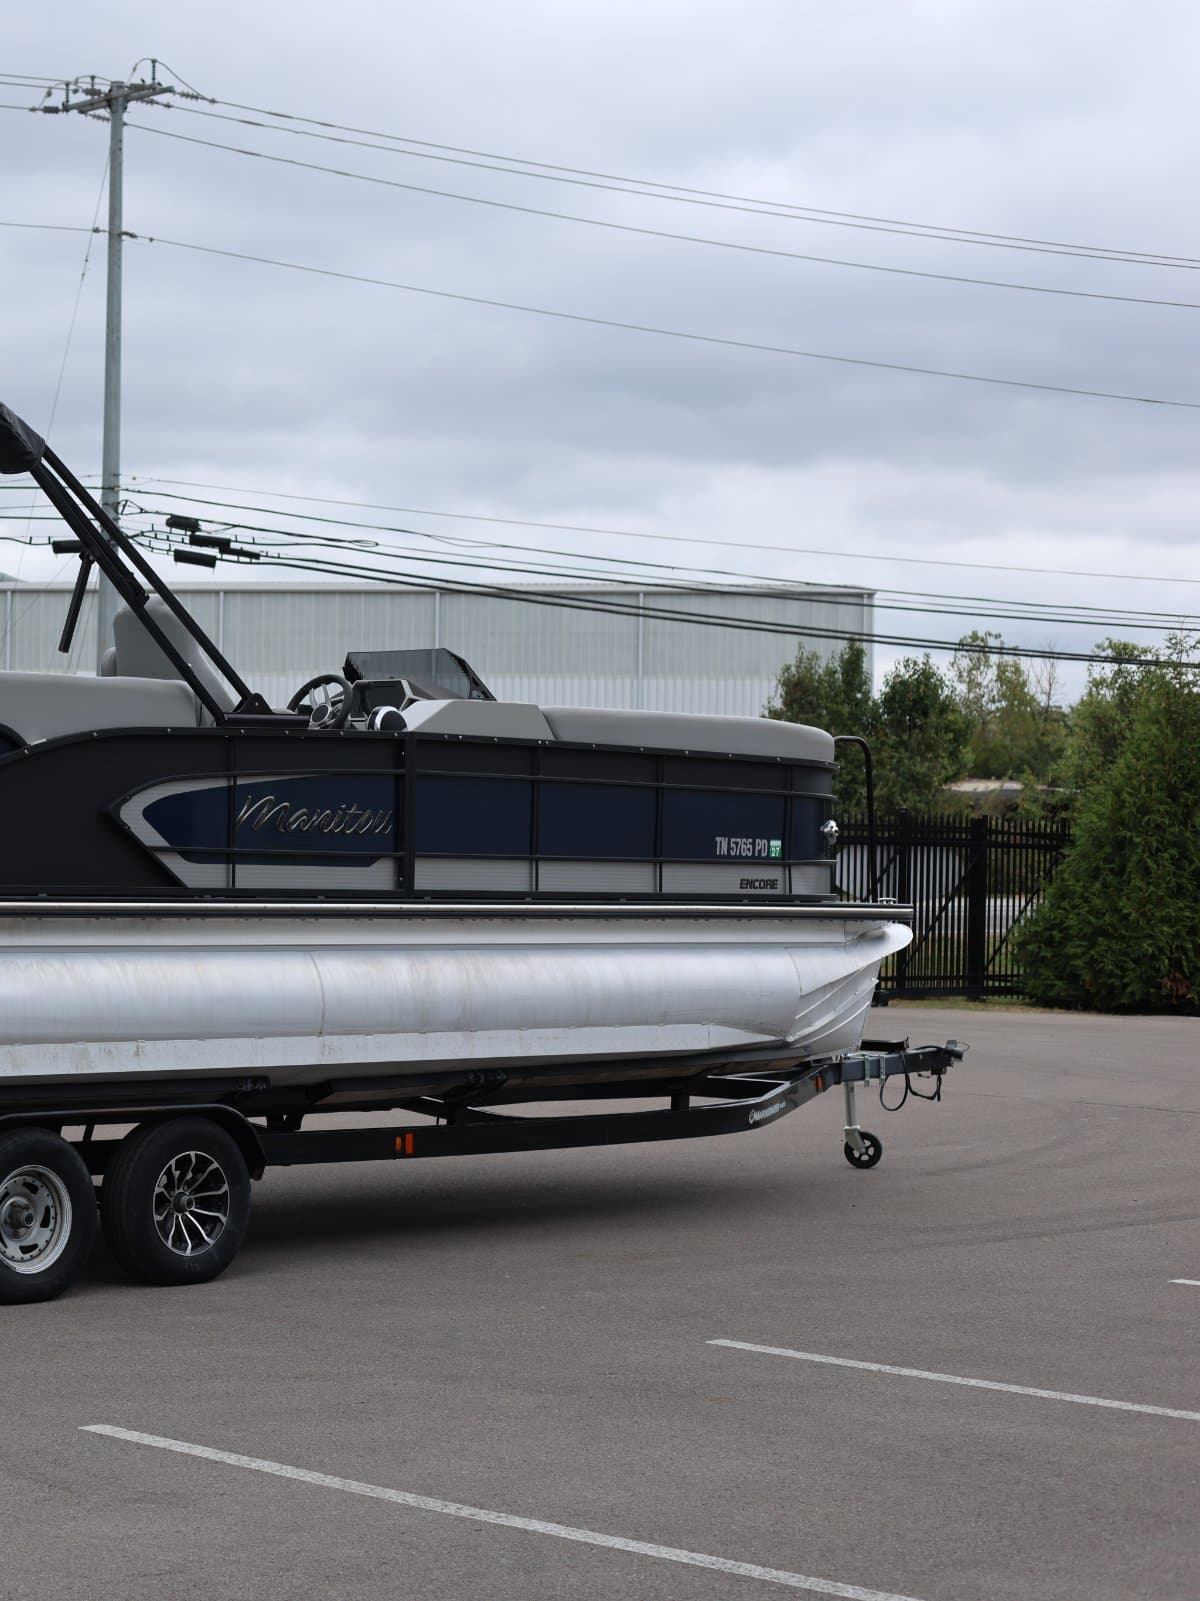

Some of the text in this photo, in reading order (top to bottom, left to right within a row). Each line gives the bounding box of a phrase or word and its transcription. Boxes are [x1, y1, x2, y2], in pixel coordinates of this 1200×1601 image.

[234, 795, 393, 834] Manitou
[716, 837, 768, 857] TN 5765 PD
[771, 847, 780, 857] 27
[740, 878, 778, 890] ENCORE
